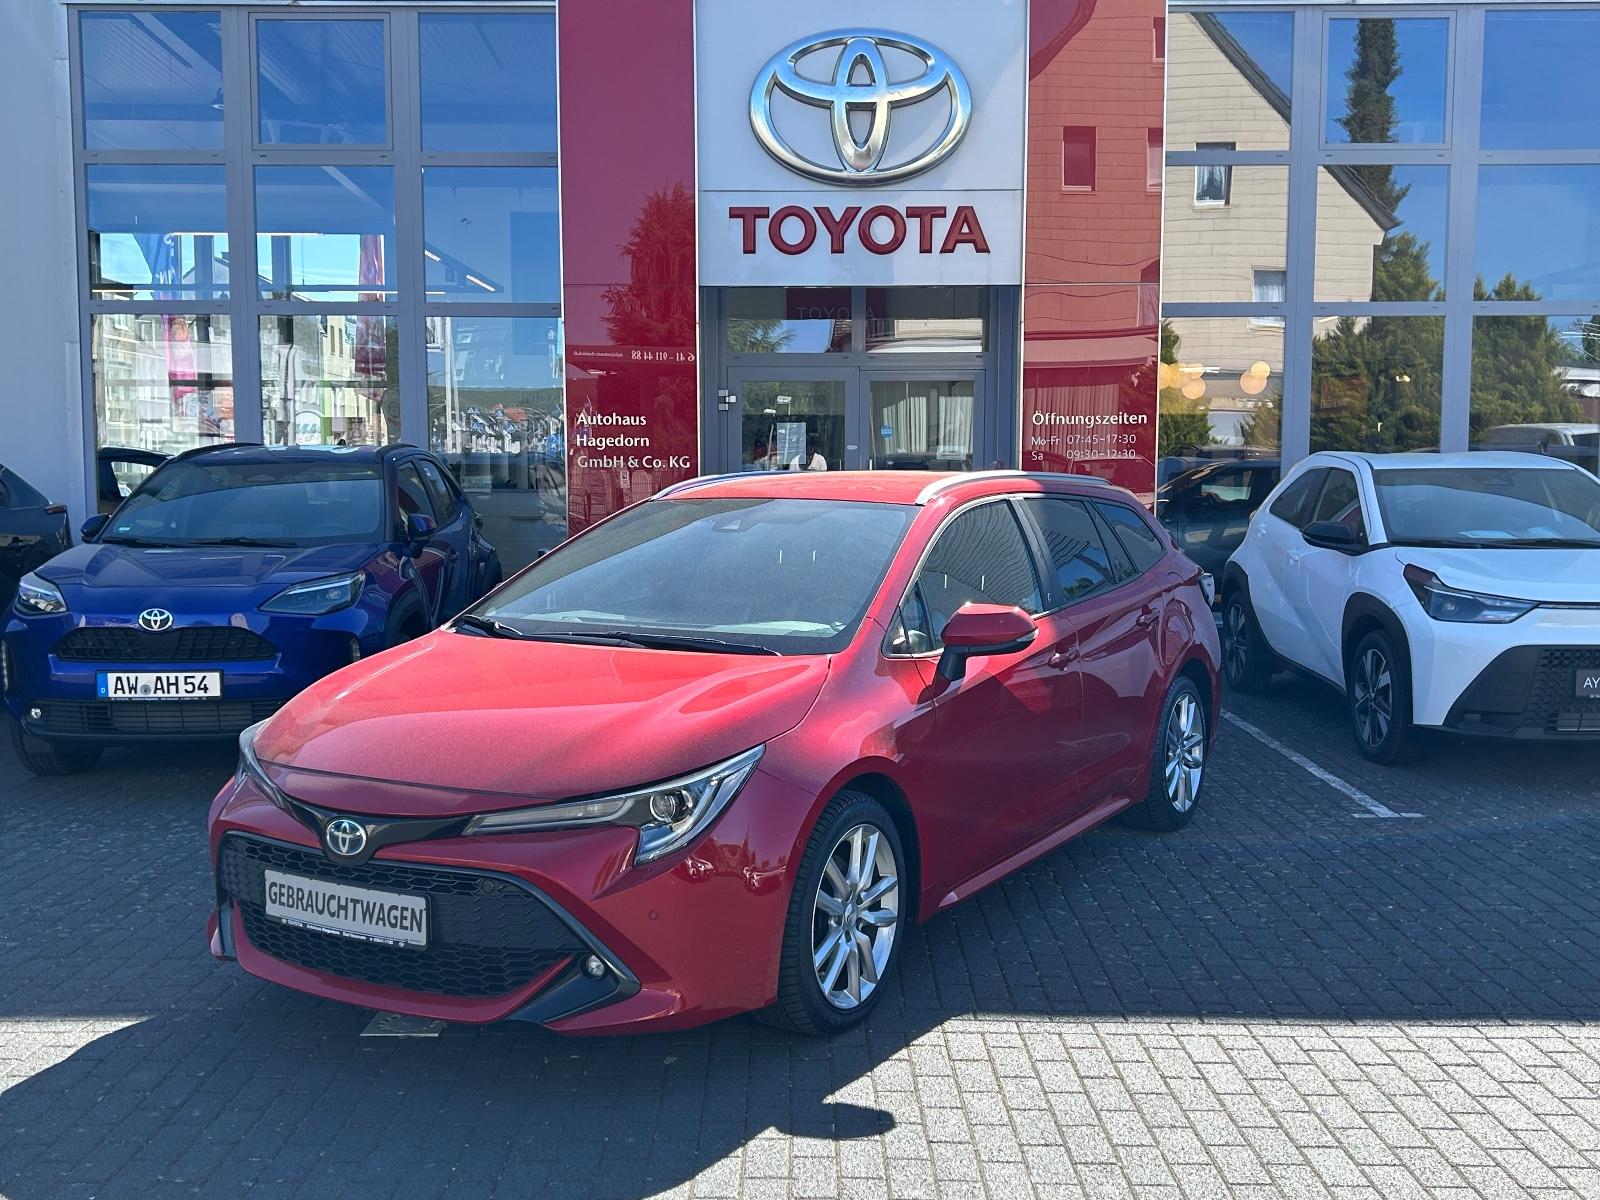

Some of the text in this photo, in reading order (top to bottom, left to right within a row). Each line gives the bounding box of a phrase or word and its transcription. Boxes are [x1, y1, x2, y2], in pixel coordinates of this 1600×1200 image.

[729, 205, 991, 255] TOYOTA
[796, 306, 875, 319] TOYOA
[576, 412, 647, 426] Autohaus
[1032, 411, 1147, 428] Öffnungszeiten
[576, 434, 650, 450] Hagedorn
[1031, 434, 1137, 446] Mo-Fr 07:45-17:30
[577, 456, 691, 469] GmbH & Co. KG
[1031, 449, 1136, 461] Sa 09:30-12:30
[113, 675, 209, 695] AW AH 54
[268, 881, 424, 933] GEBRAUCHTWAGEN
